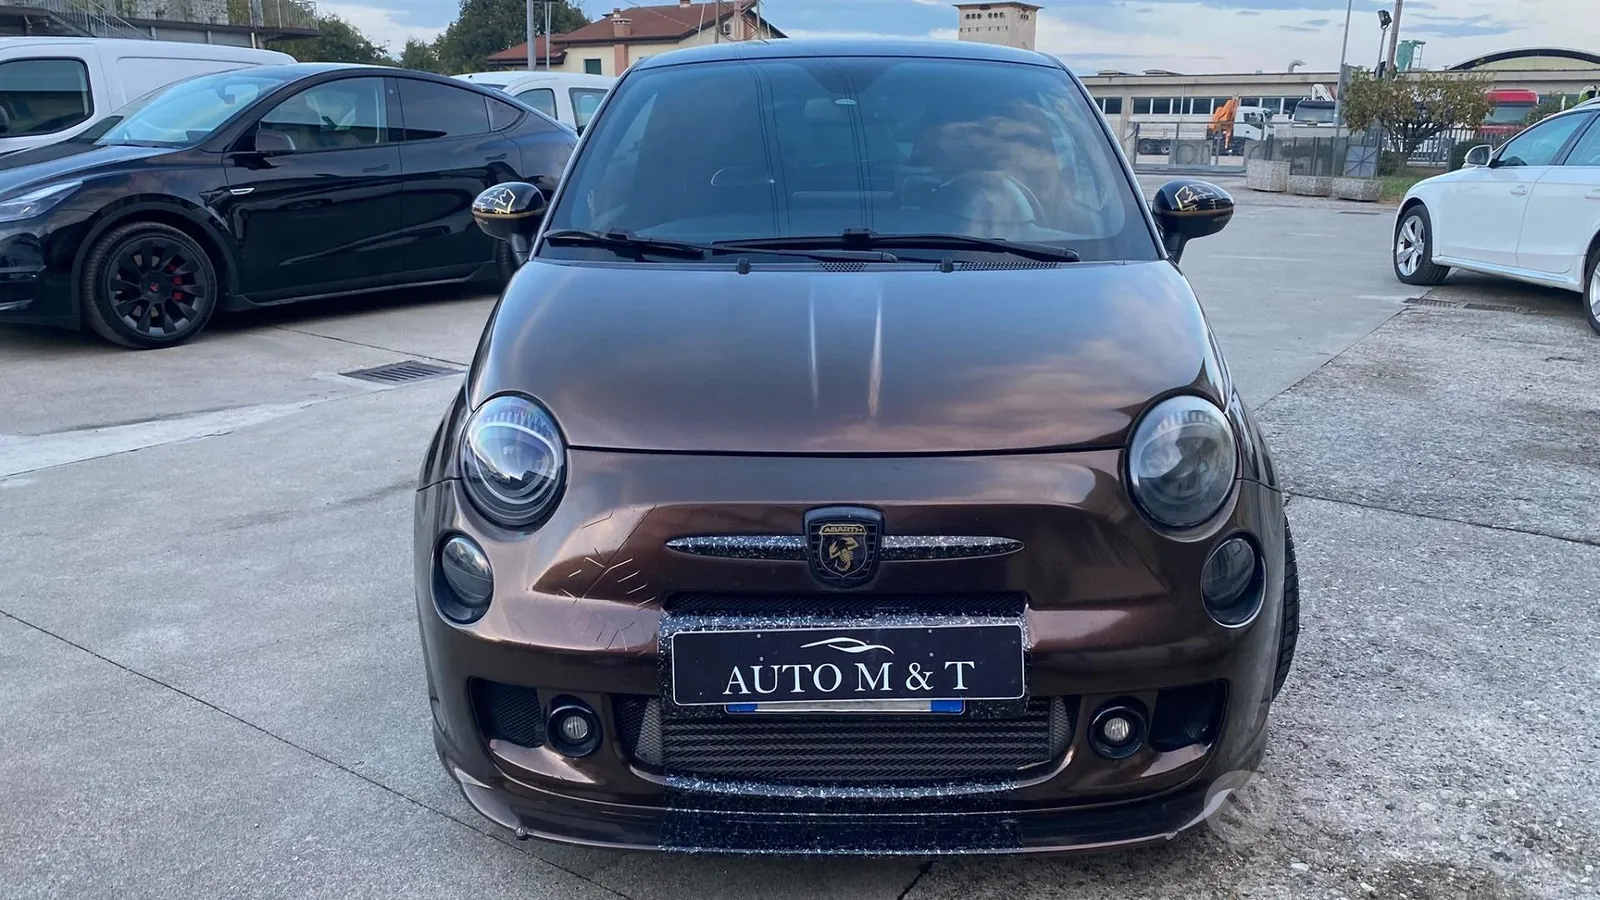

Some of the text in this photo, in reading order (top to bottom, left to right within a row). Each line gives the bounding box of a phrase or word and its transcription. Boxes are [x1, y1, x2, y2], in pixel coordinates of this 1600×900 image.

[722, 660, 975, 695] AUTO M & T
